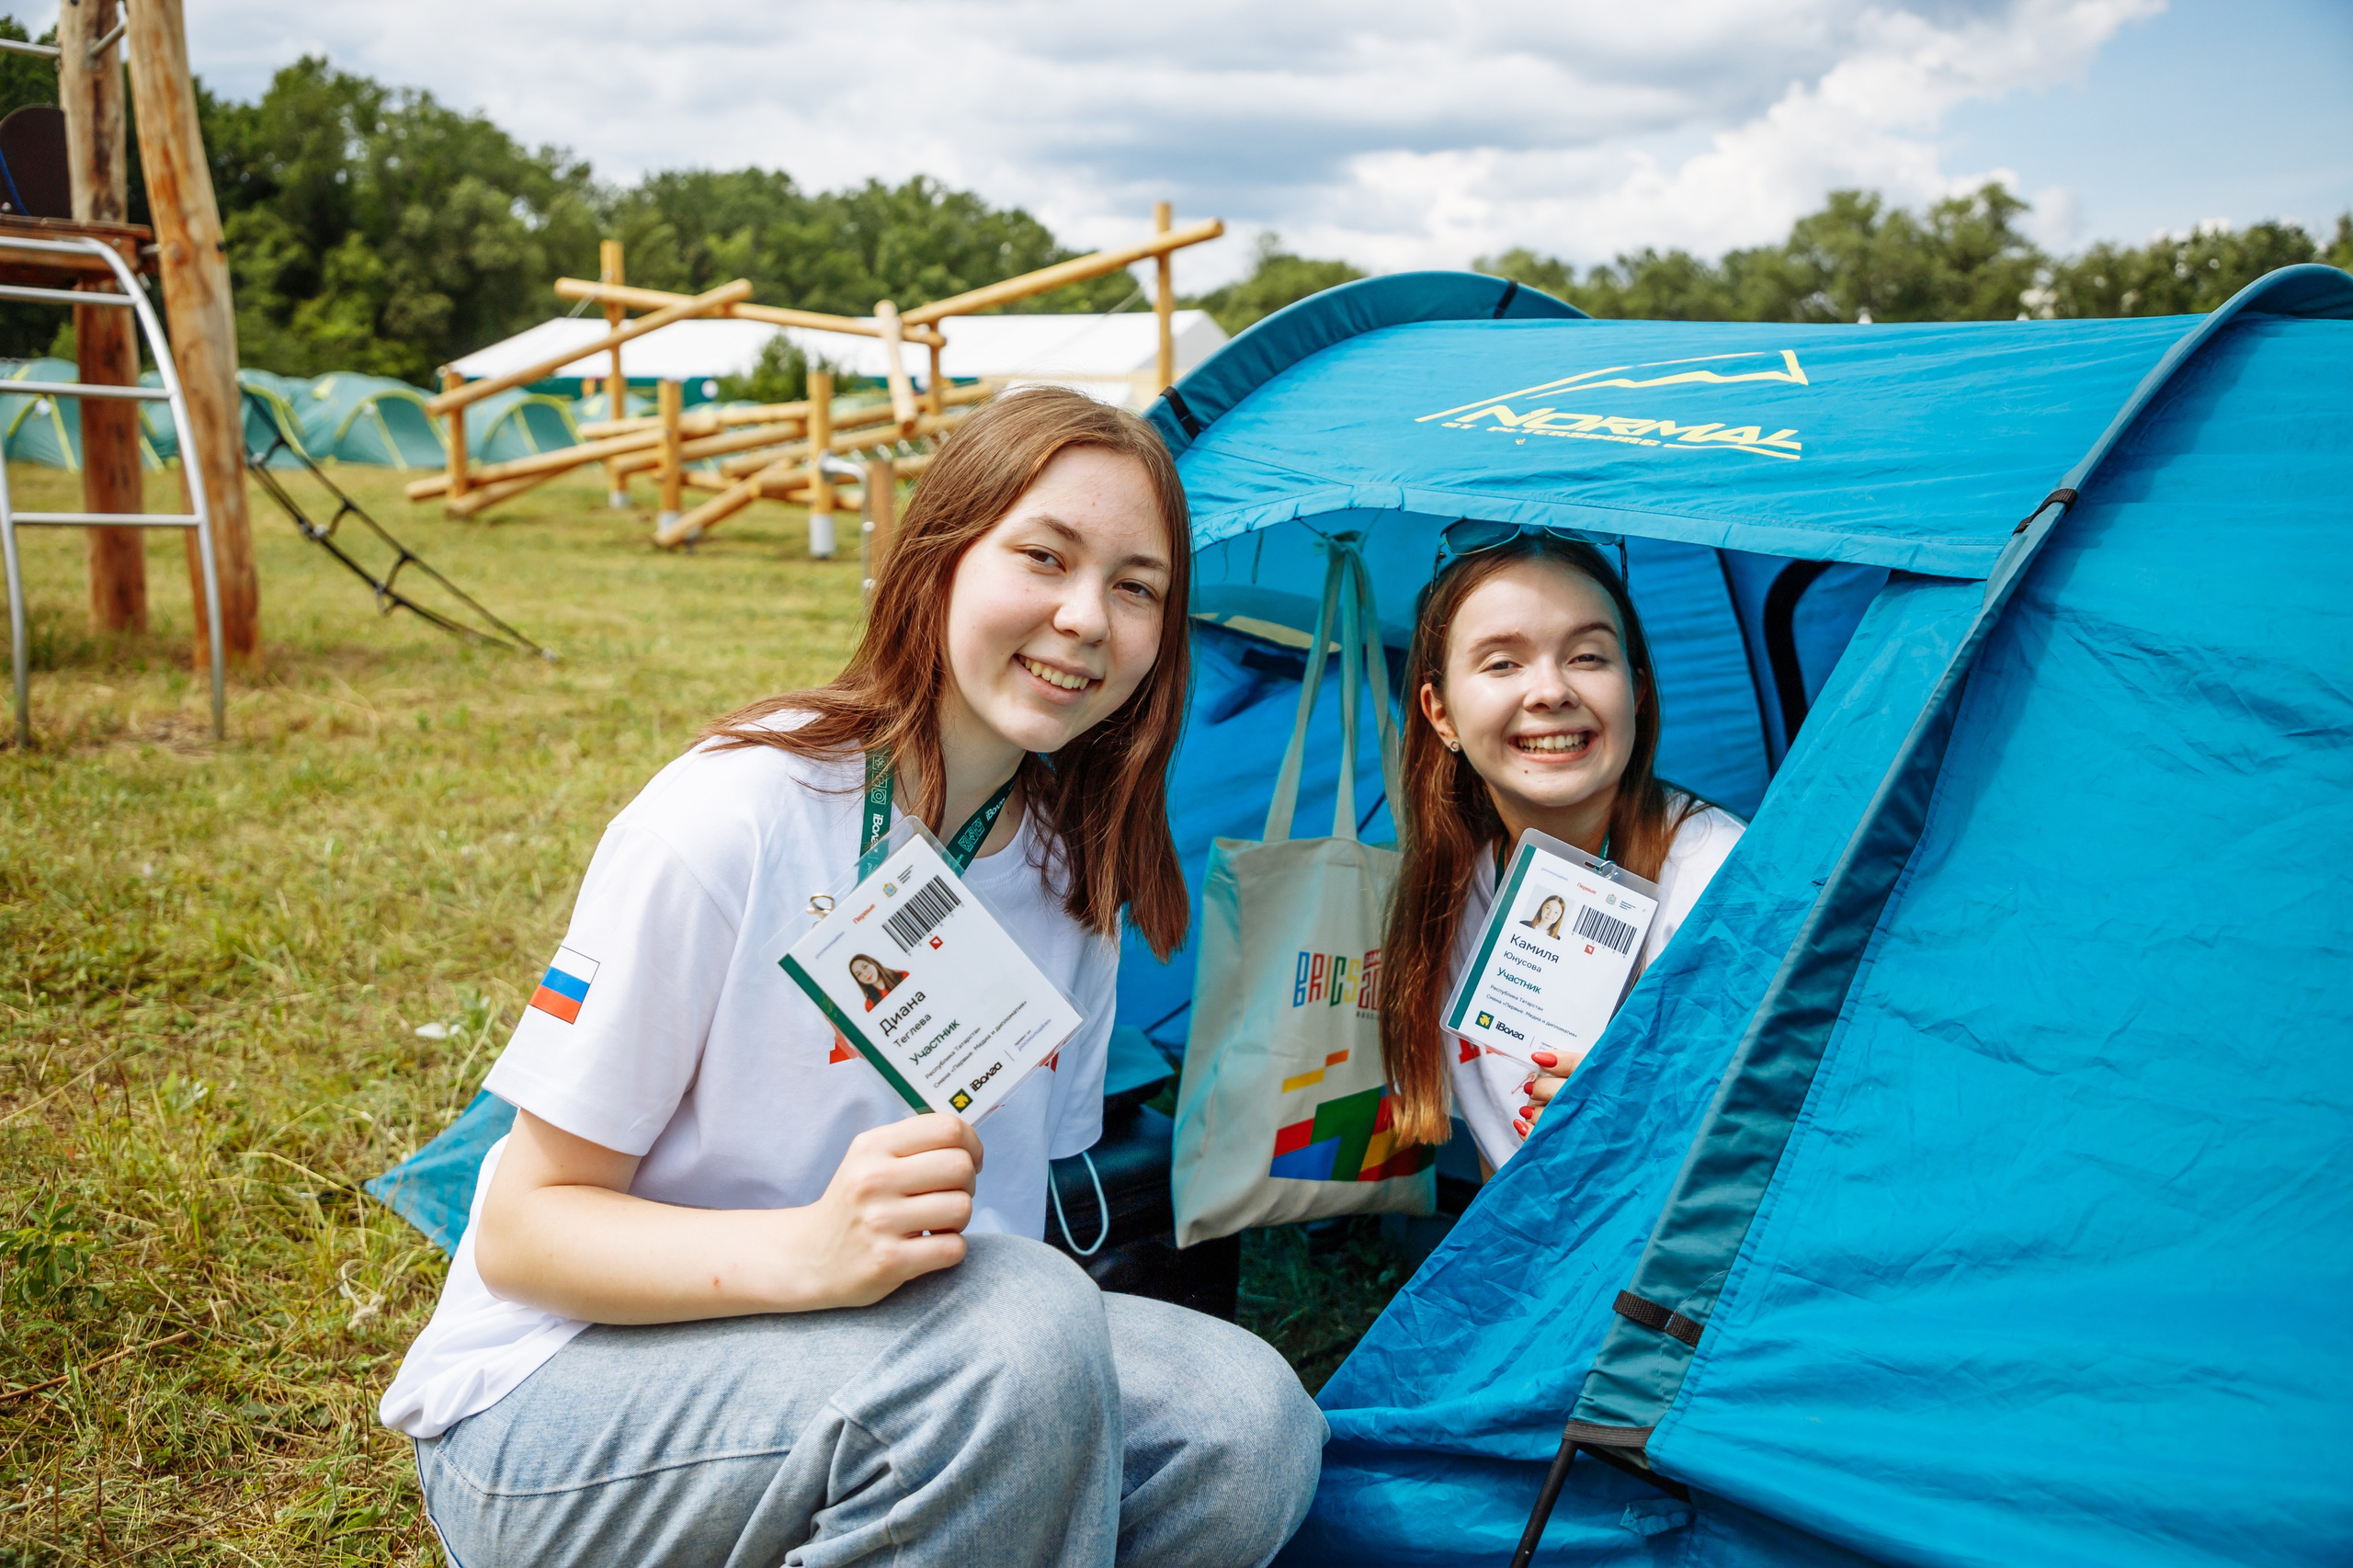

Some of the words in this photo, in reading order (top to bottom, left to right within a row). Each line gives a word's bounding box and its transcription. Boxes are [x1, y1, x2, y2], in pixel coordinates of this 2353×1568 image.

[1455, 404, 1802, 450] NORMAL
[1504, 950, 1541, 972] Юнусова
[1510, 934, 1559, 963] Камиля
[1293, 951, 1362, 1007] BRICS
[1490, 984, 1518, 1000] Республика
[1519, 997, 1543, 1011] Татарстан
[1497, 967, 1541, 994] Участник
[880, 992, 926, 1037] Диана
[893, 1014, 932, 1047] Теглева
[909, 1019, 961, 1065] Участник
[925, 1051, 956, 1079] Республика
[954, 1028, 981, 1051] Татарстан
[934, 1073, 951, 1088] Смена
[973, 1035, 991, 1051] Медиа
